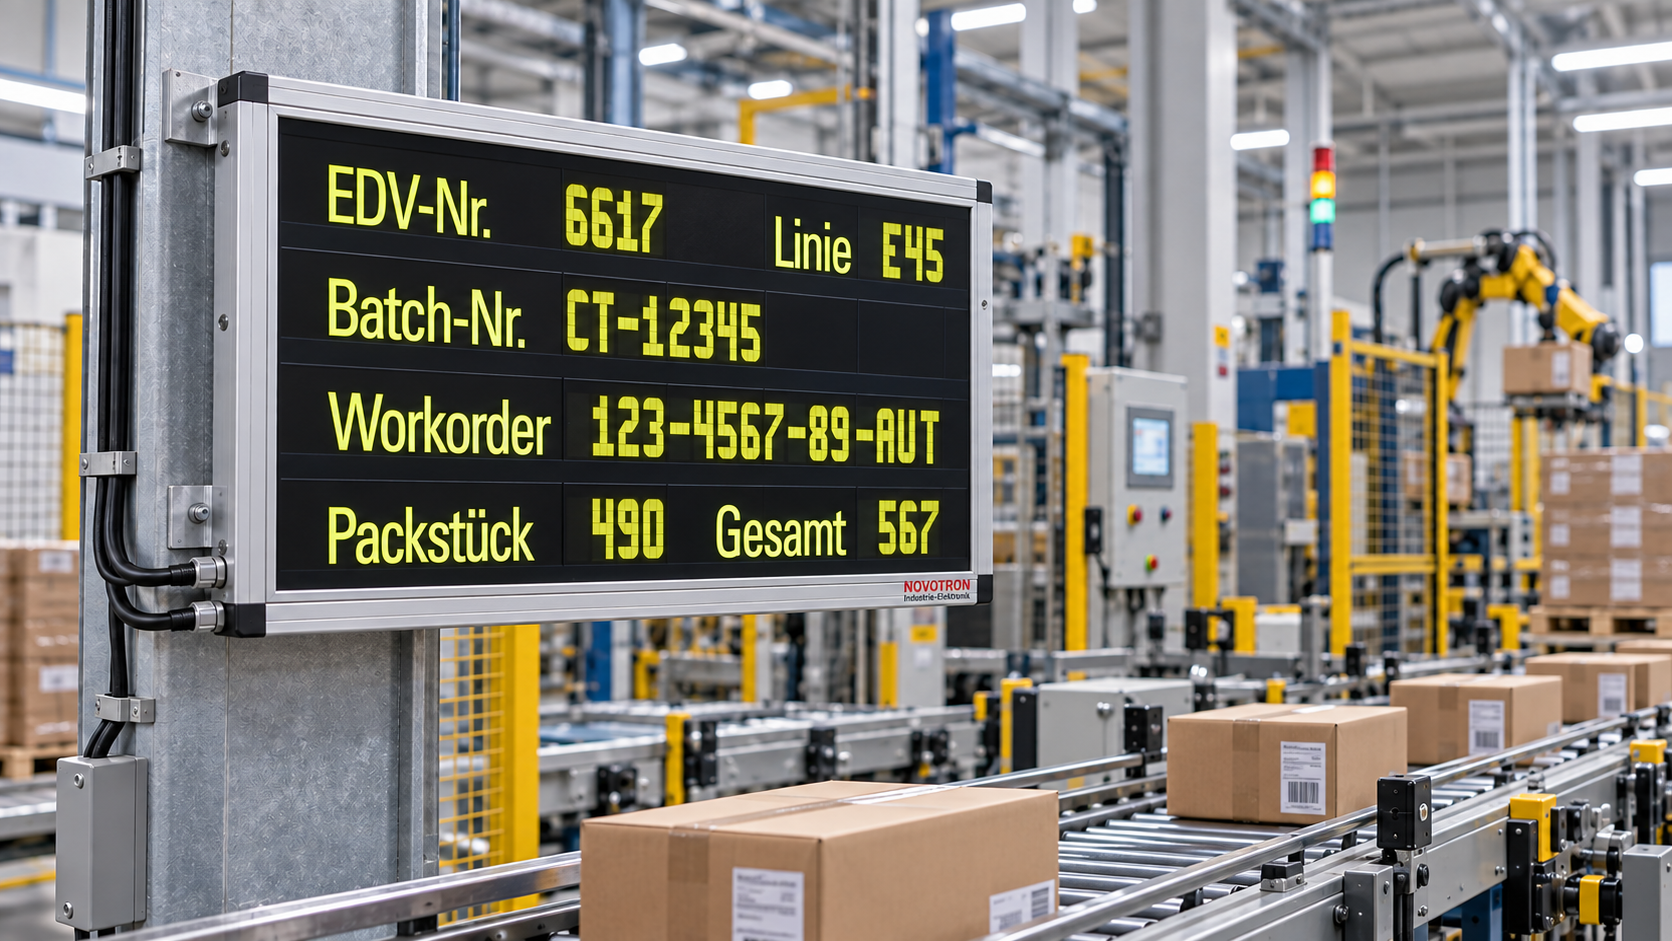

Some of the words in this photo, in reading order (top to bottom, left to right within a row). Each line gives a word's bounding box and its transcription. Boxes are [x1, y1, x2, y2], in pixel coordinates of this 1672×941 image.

[327, 164, 492, 240] EDV-Nr.
[565, 183, 664, 254] 6617
[775, 215, 853, 275] Linie
[882, 222, 945, 284] E45
[327, 277, 527, 350] Batch-Nr.
[566, 288, 762, 364] CT-12345
[327, 391, 552, 457] Workorder
[591, 395, 940, 465] 123-4567-89-AUT
[327, 506, 535, 565] Packstück
[591, 498, 665, 560] 490
[716, 503, 848, 560] Gesamt
[878, 500, 940, 556] 567
[903, 579, 971, 593] NOVOTRON
